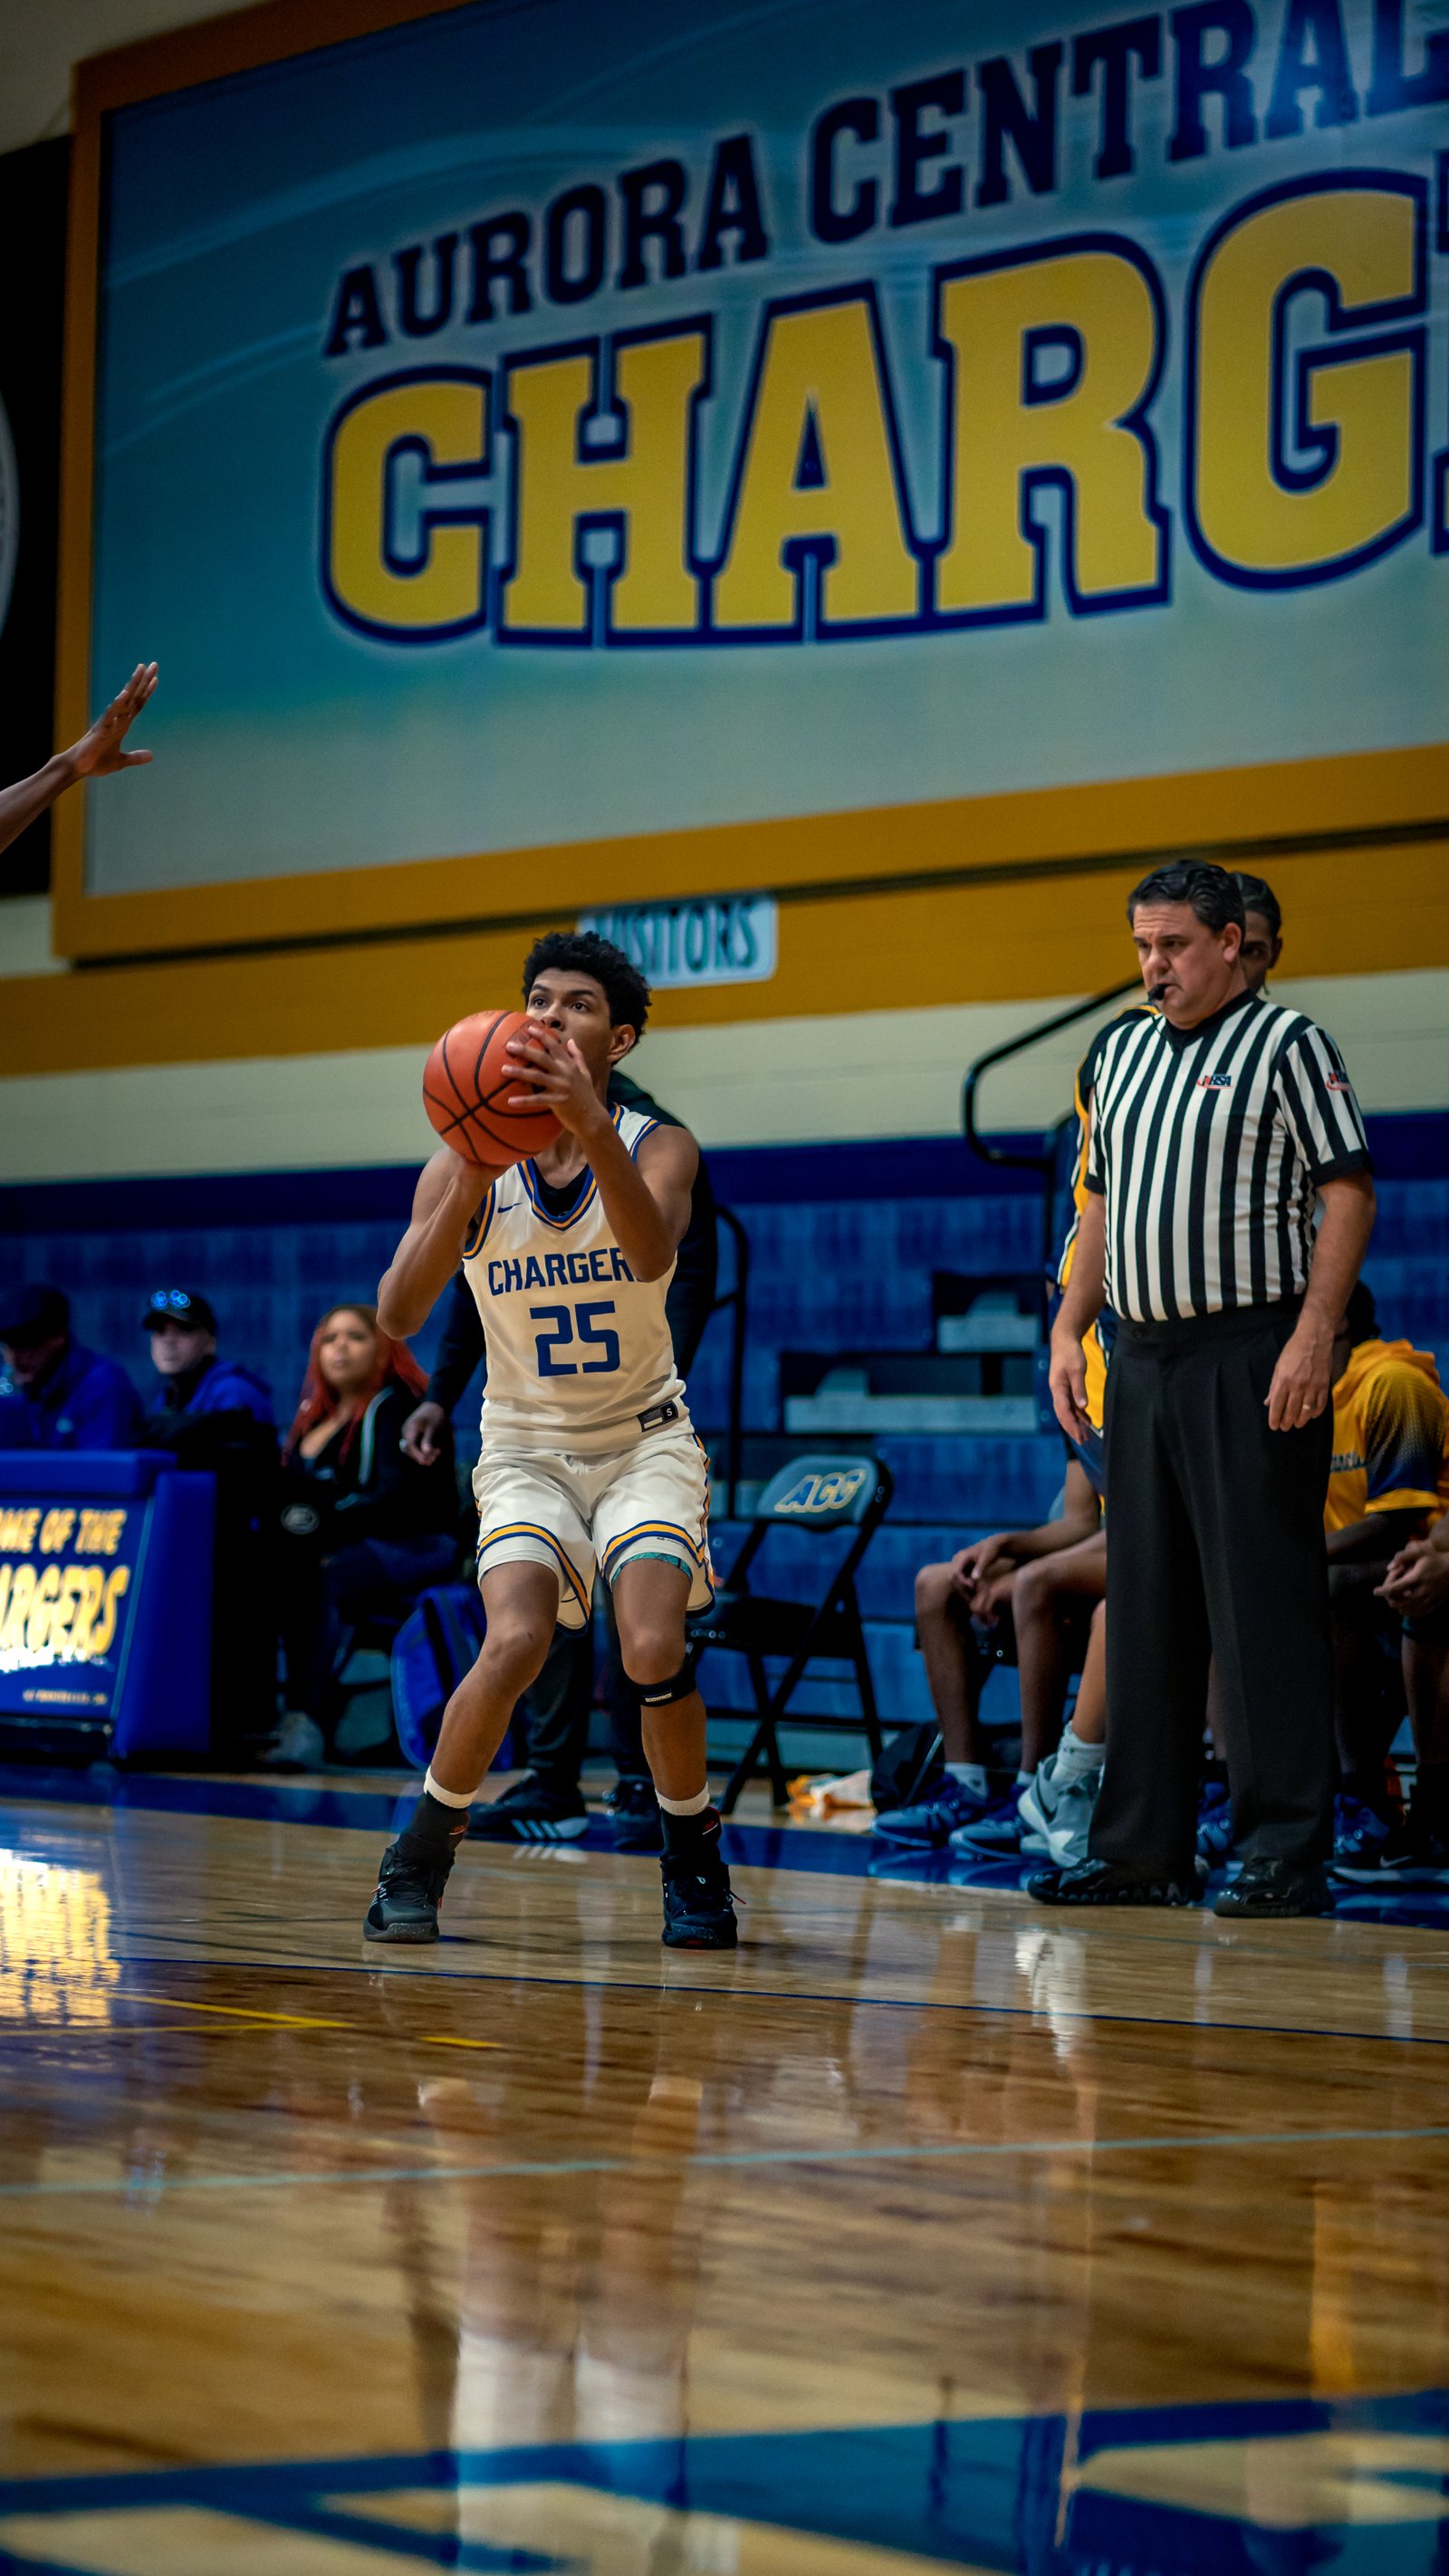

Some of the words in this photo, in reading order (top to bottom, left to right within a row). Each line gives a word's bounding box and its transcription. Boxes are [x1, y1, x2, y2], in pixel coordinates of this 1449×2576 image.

[325, 135, 769, 356] AURORA
[810, 0, 1449, 245] CENTRAL
[320, 149, 1449, 649] CHARG
[488, 1247, 642, 1296] CHARGER
[529, 1301, 620, 1377] 25
[667, 1408, 673, 1417] S
[40, 1508, 76, 1554] OF
[75, 1508, 127, 1555] THE
